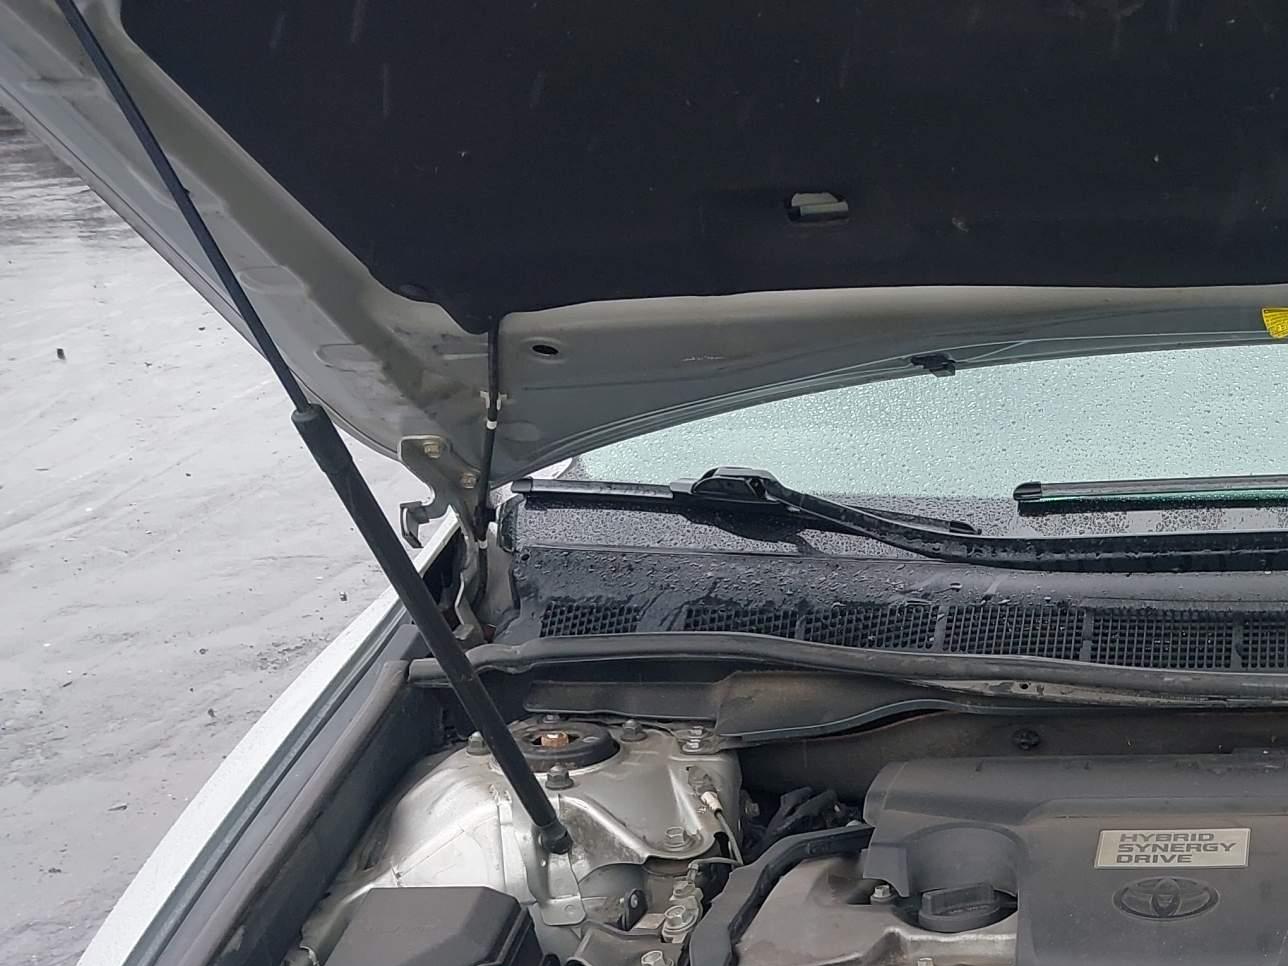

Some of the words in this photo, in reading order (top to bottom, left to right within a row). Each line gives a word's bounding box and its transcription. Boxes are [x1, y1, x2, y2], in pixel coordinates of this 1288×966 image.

[1120, 833, 1215, 842] HYBRID
[1118, 843, 1237, 852] SYNERGY
[1116, 854, 1193, 864] DRIVE
